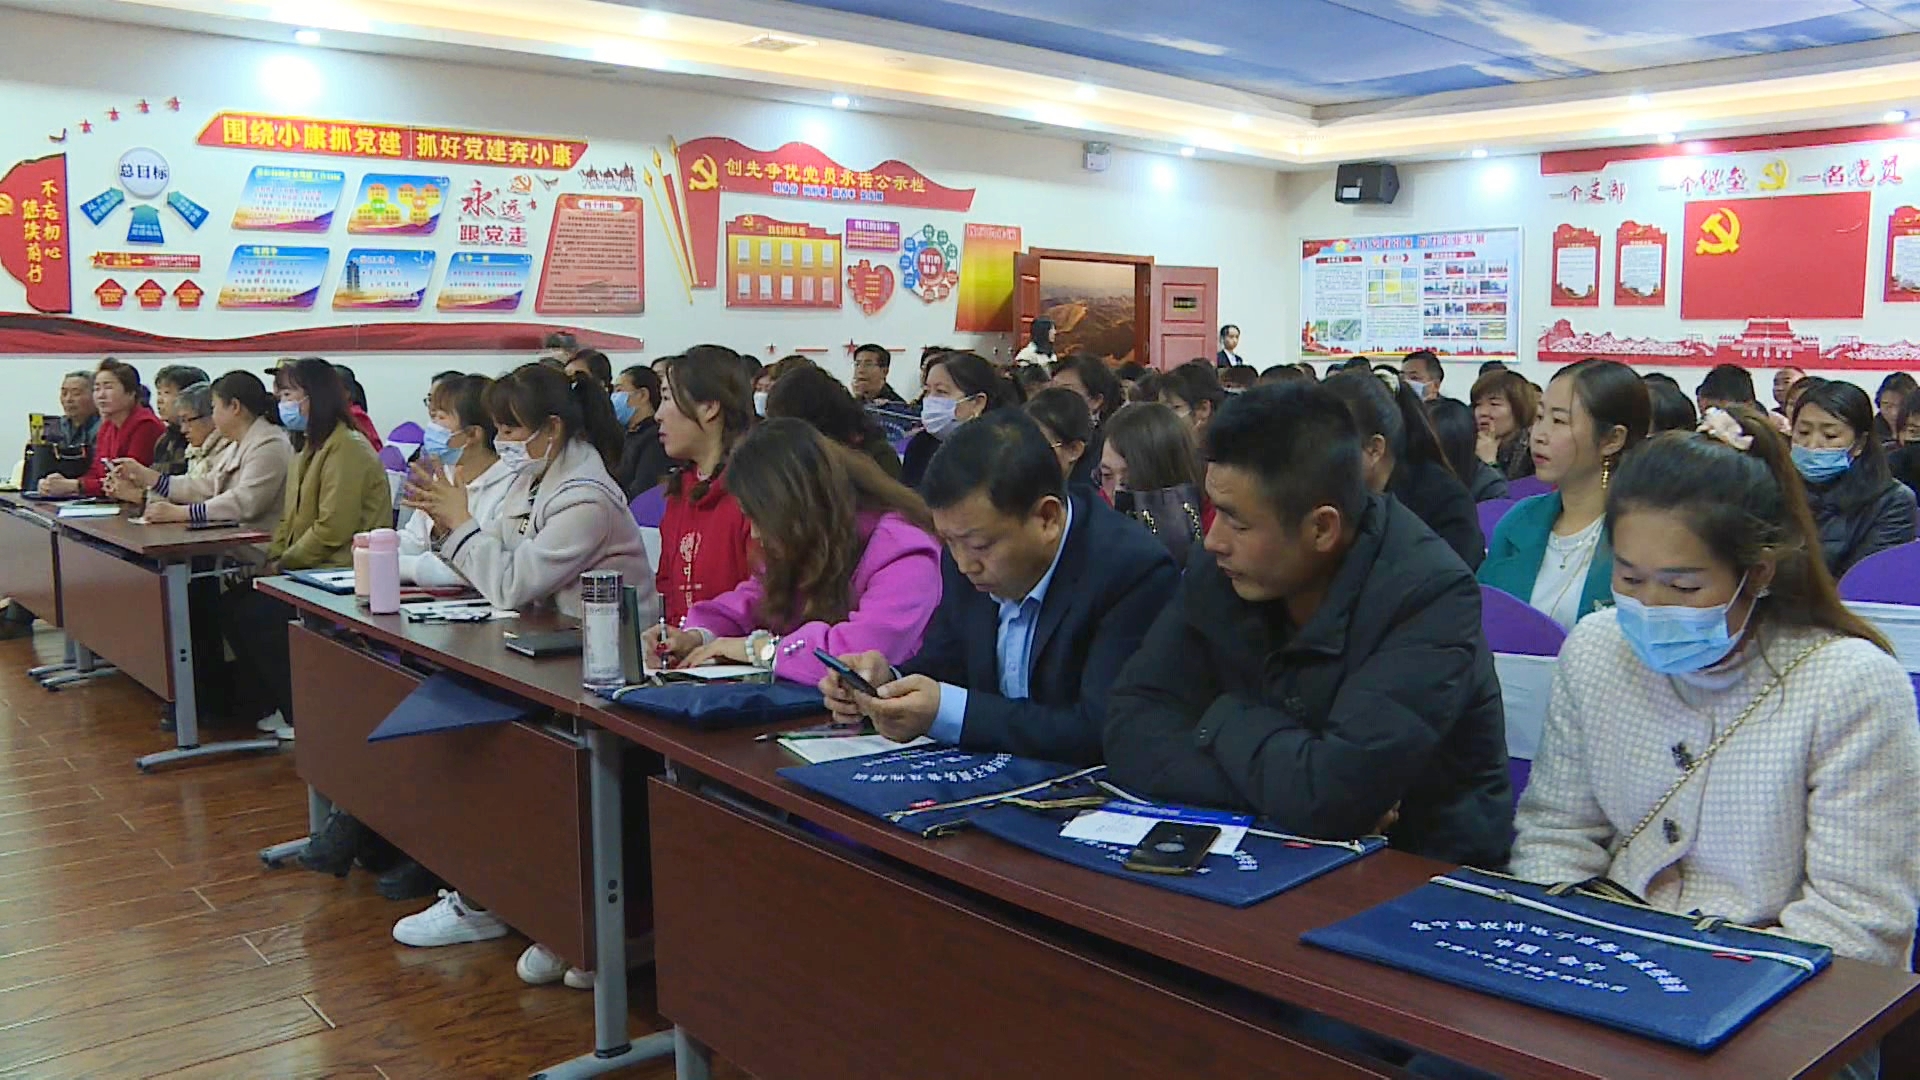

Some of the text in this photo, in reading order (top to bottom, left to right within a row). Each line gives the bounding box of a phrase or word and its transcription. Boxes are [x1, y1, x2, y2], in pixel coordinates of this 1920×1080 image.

[223, 116, 572, 167] 围绕小康抓党建 抓好党建奔小康
[119, 164, 169, 180] 总目标
[724, 157, 927, 193] 创先争优党员承诺公示栏
[1549, 178, 1627, 204] 一个支部
[1799, 155, 1904, 185] 一名党员
[41, 179, 62, 259] 不忘初心
[460, 225, 526, 244] 跟党走
